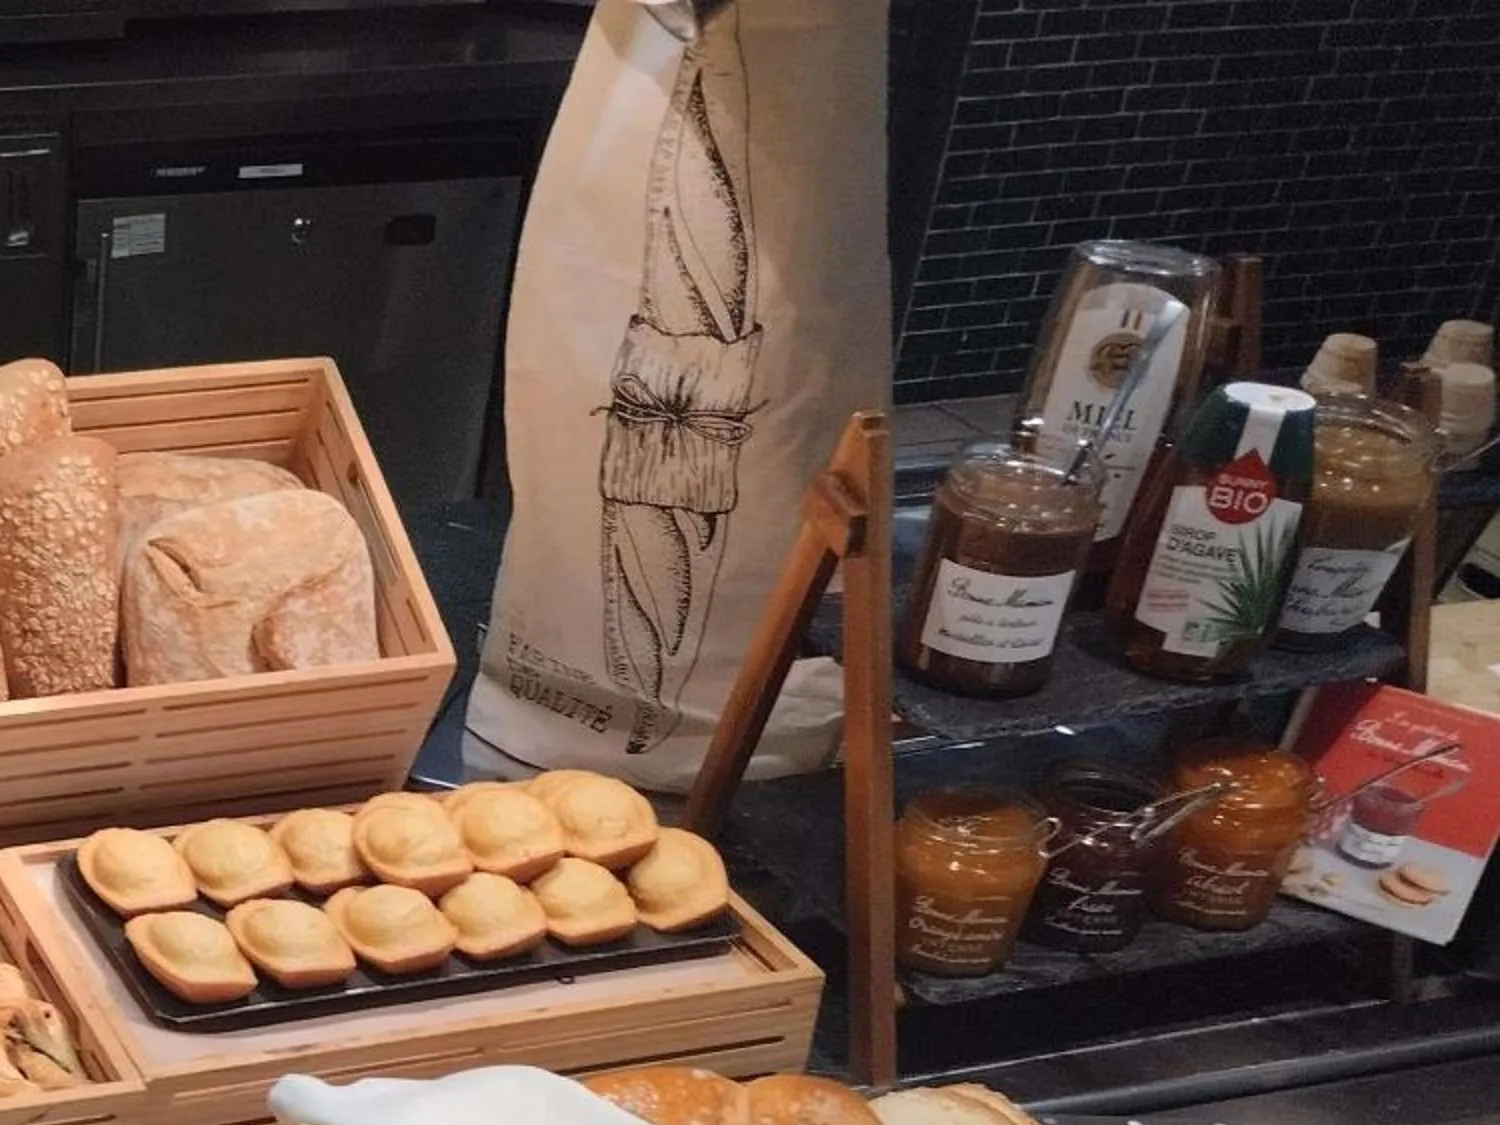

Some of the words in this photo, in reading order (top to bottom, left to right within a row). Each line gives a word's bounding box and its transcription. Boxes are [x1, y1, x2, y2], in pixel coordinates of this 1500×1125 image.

[1209, 485, 1269, 515] BIO
[1170, 523, 1217, 541] SIROP
[1166, 537, 1239, 563] D'AGAVE
